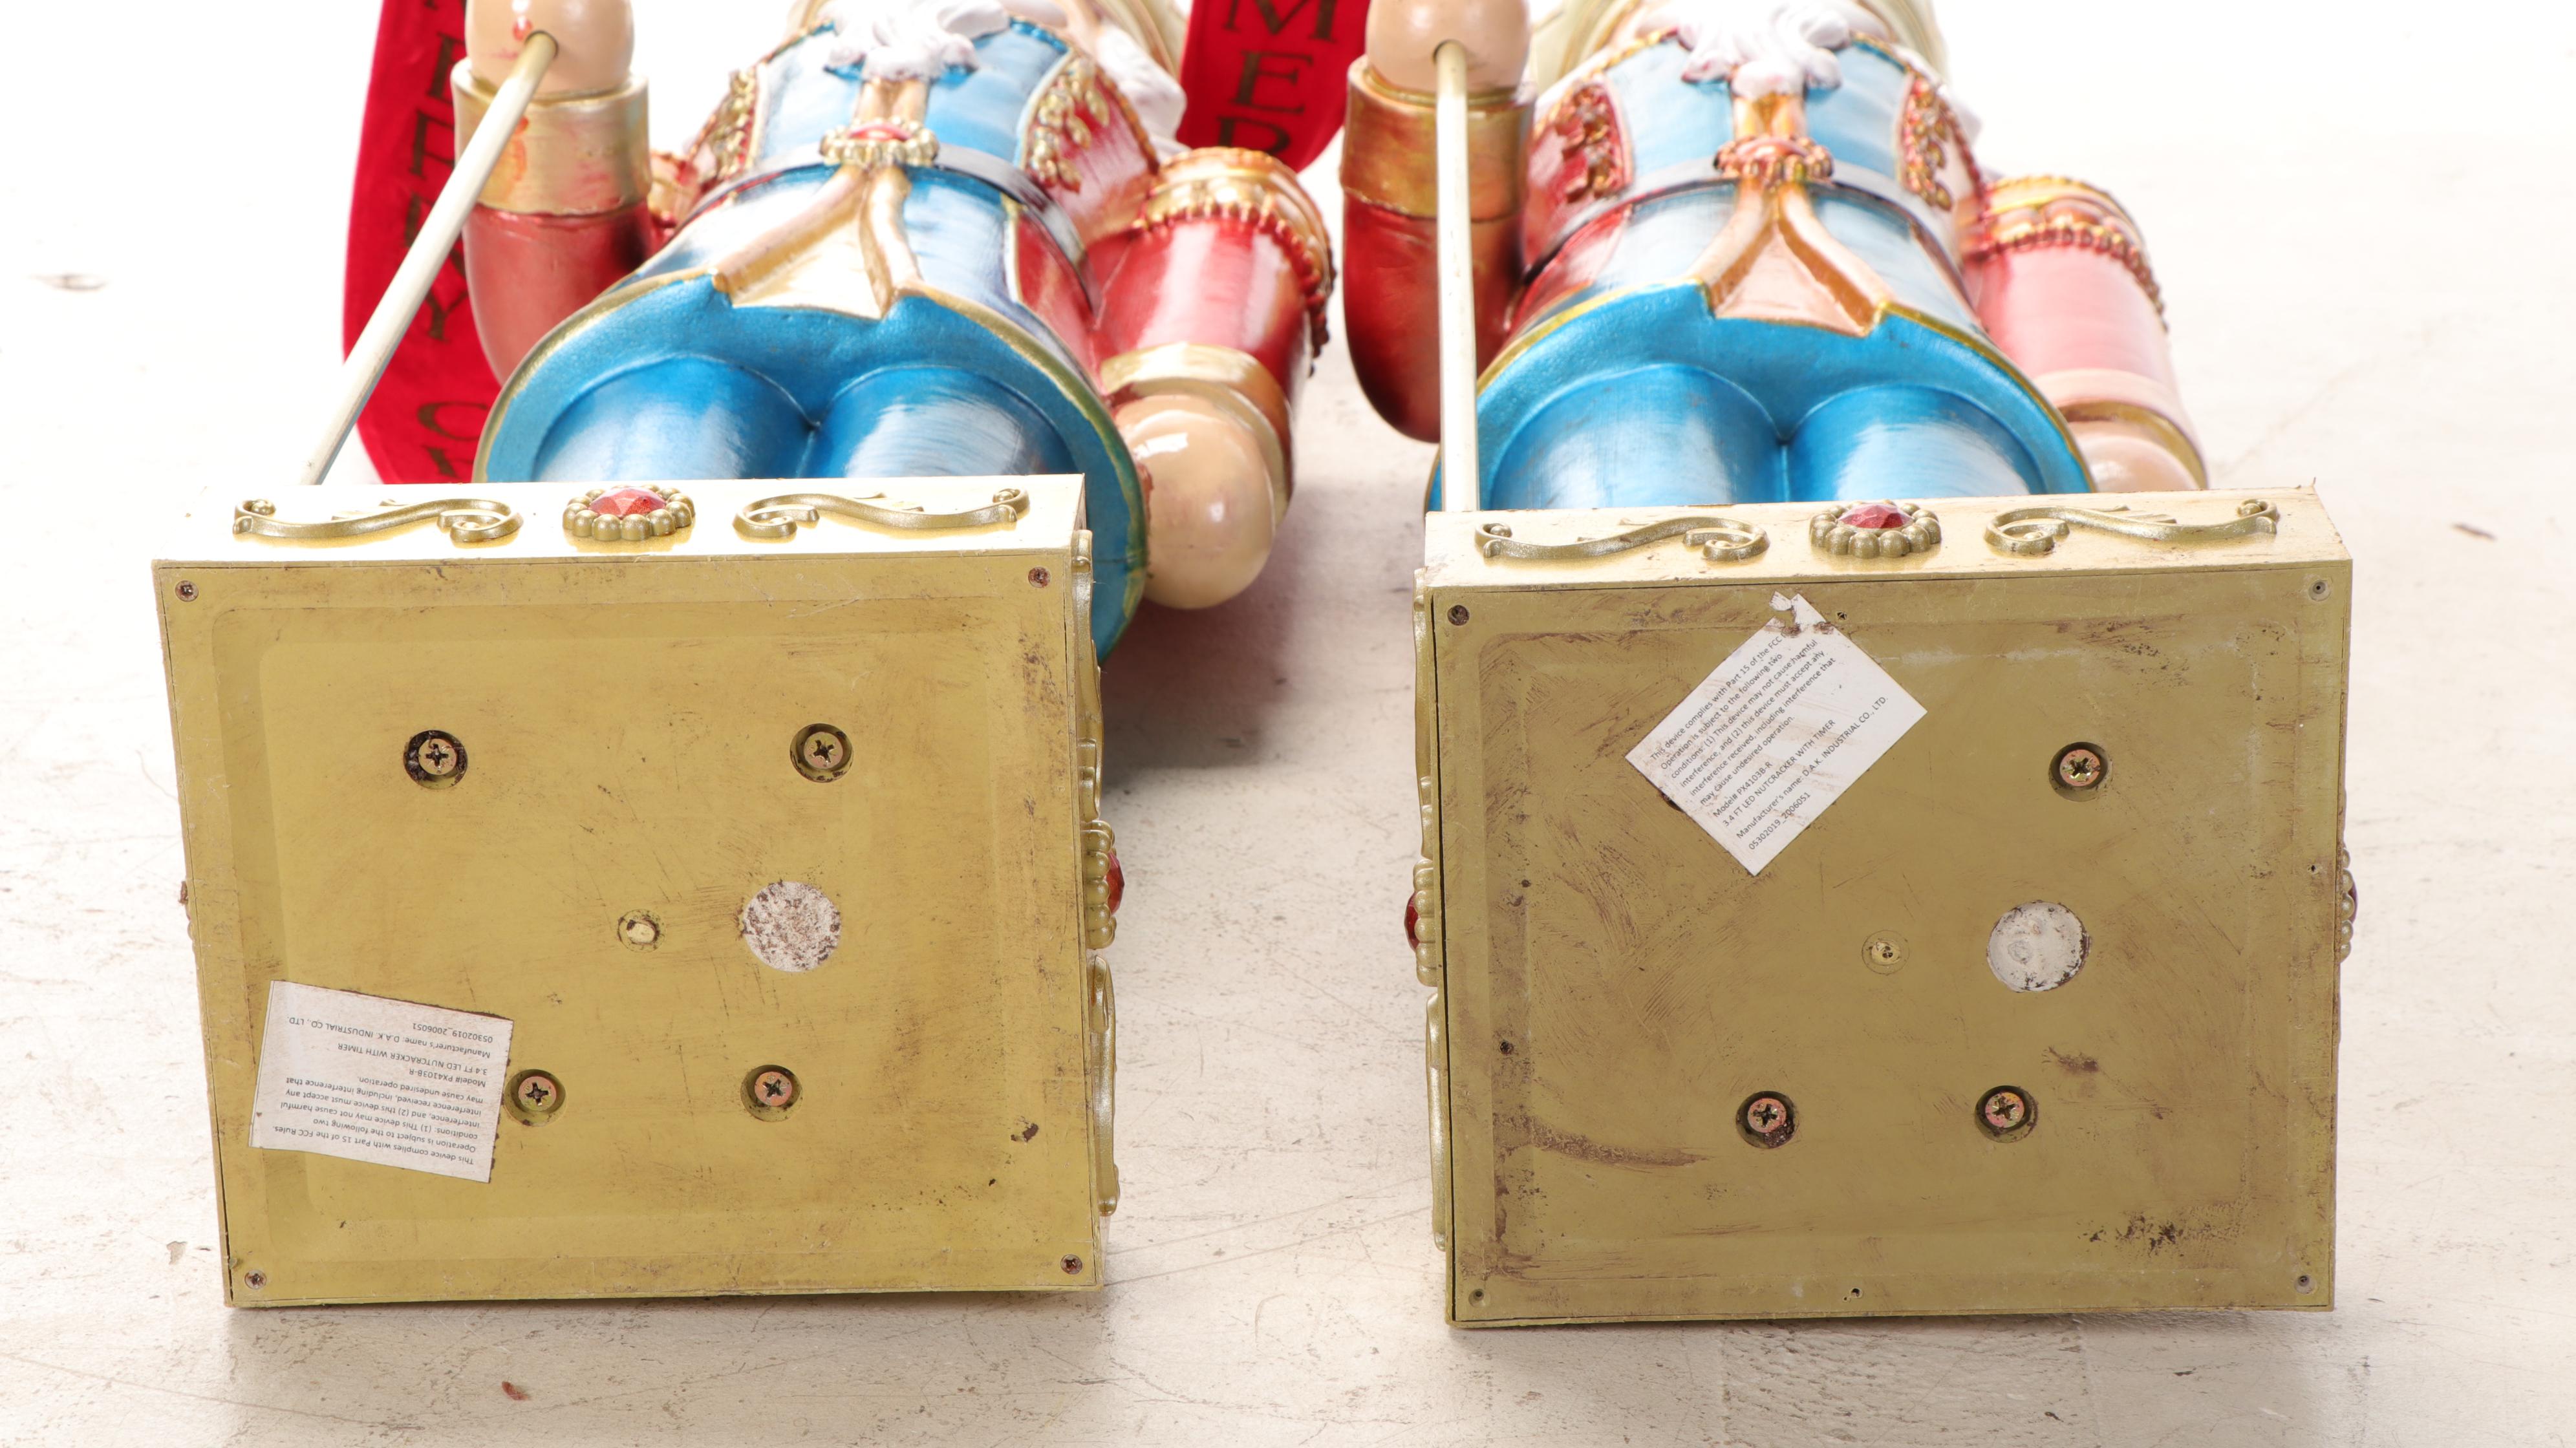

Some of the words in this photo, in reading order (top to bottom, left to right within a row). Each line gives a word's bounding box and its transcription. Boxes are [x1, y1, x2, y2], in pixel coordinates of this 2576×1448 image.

[1649, 746, 1666, 761] This
[1663, 727, 1686, 749] device
[1683, 700, 1714, 730] complies
[1710, 686, 1728, 703] with
[1725, 673, 1742, 688] Part
[1755, 646, 1770, 660] the
[1767, 635, 1783, 649] FCC
[1702, 734, 1716, 747] (1)
[1712, 722, 1728, 736] This
[1726, 703, 1749, 725] device
[1747, 690, 1764, 706] may
[1761, 678, 1775, 692] not
[1773, 662, 1793, 681] cause
[1790, 638, 1818, 664] harmful
[1718, 736, 1733, 751] and
[1730, 727, 1744, 740] (2)
[1739, 714, 1755, 729] this
[1752, 696, 1776, 718] device
[1772, 680, 1792, 698] must
[1789, 660, 1814, 683] accept
[1810, 650, 1826, 663] any
[1659, 738, 1694, 771] Operation
[1697, 710, 1723, 735] subject
[1726, 692, 1741, 705] the
[1737, 665, 1771, 695] following
[1766, 652, 1783, 666] two
[1688, 759, 1728, 796] interference
[1754, 705, 1785, 735] including
[1781, 670, 1821, 708] interference
[1819, 657, 1836, 672] that
[1820, 721, 1861, 758] INDUSTRIAL
[1699, 791, 1717, 807] may
[1713, 773, 1733, 792] cause
[1730, 743, 1763, 775] undesired
[1721, 814, 1735, 827] 3.4
[1741, 794, 1756, 809] LED
[1753, 755, 1798, 796] NUTCRACKER
[1794, 738, 1815, 758] WITH
[1812, 719, 1836, 740] TIMER
[1712, 793, 1738, 818] Model#
[325, 1023, 373, 1038] INDUSTRIAL
[337, 1043, 363, 1054] TIMER
[365, 1048, 388, 1058] WITH
[390, 1052, 444, 1068] NUTCRACKER
[445, 1061, 462, 1070] LED
[475, 1067, 488, 1075] 3.4
[285, 1076, 303, 1086] that
[455, 1076, 486, 1087] Model#
[285, 1087, 301, 1096] any
[305, 1080, 354, 1094] interference
[400, 1083, 440, 1096] undesired
[302, 1091, 329, 1102] accept
[356, 1087, 392, 1100] including
[441, 1091, 464, 1100] cause
[466, 1094, 484, 1103] may
[330, 1096, 351, 1106] must
[352, 1100, 379, 1111] device
[280, 1101, 313, 1113] harmful
[314, 1106, 338, 1115] cause
[380, 1105, 396, 1114] this
[397, 1106, 409, 1116] (2)
[432, 1102, 482, 1116] interference
[354, 1111, 372, 1121] may
[411, 1110, 426, 1119] and
[312, 1118, 328, 1127] two
[330, 1119, 369, 1134] following
[374, 1116, 400, 1127] device
[402, 1121, 418, 1130] This
[297, 1129, 314, 1138] FCC
[370, 1128, 383, 1136] the
[420, 1123, 432, 1133] (1)
[315, 1131, 329, 1140] the
[396, 1131, 425, 1144] subject
[354, 1137, 370, 1146] Part
[372, 1140, 391, 1149] with
[435, 1138, 476, 1153] Operation
[392, 1142, 429, 1156] complies
[430, 1150, 456, 1161] device
[458, 1155, 474, 1164] This
